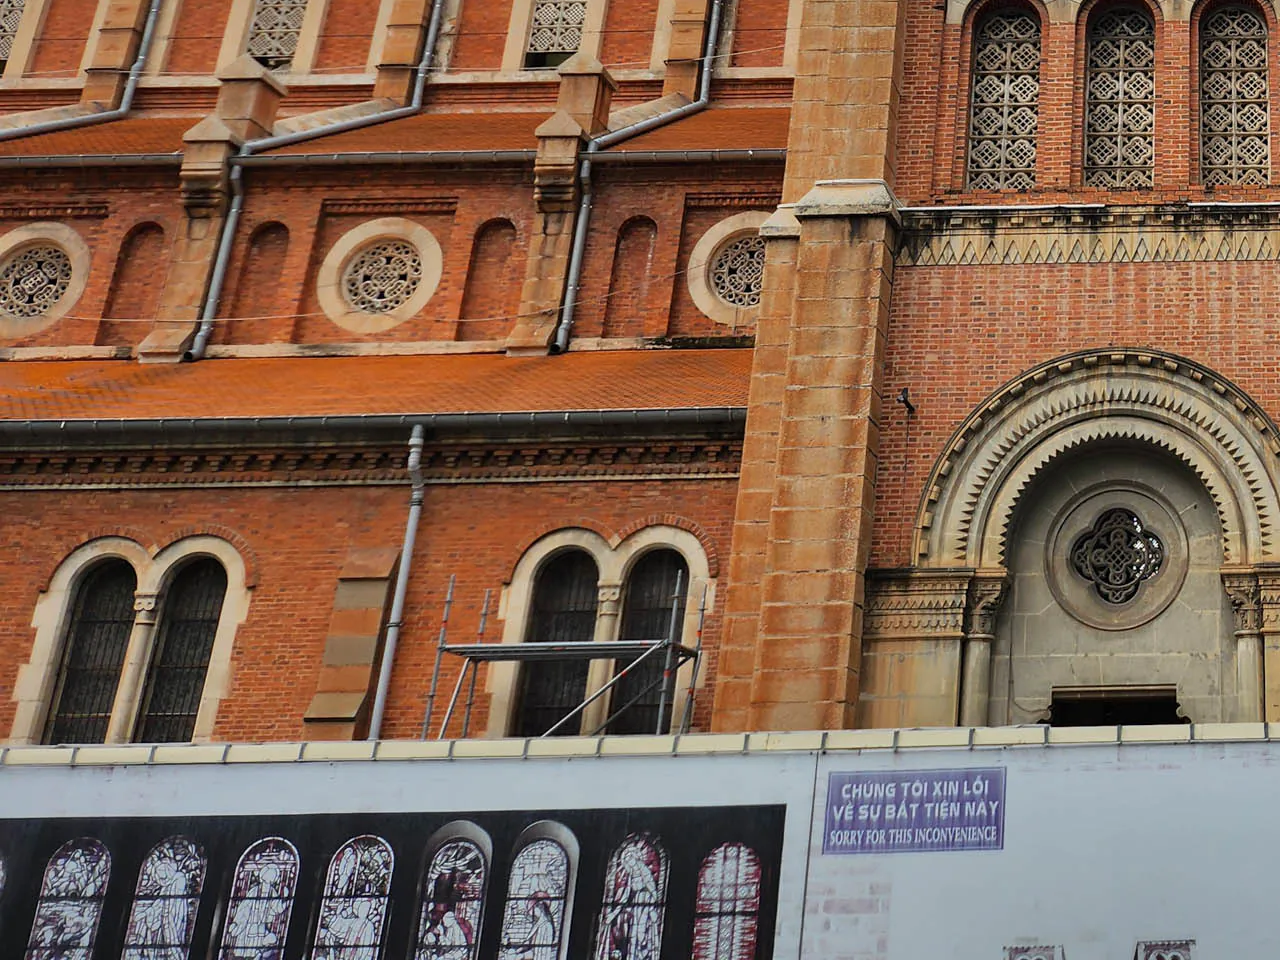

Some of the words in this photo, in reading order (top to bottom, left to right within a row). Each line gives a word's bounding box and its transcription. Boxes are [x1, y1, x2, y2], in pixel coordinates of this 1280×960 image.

[841, 780, 897, 799] CHÚNG
[901, 780, 927, 797] TÔI
[932, 780, 959, 796] XIN
[924, 800, 961, 820] TIỆN
[965, 799, 999, 818] NÀY
[830, 829, 863, 846] SORRY
[865, 828, 886, 844] FOR
[889, 827, 913, 844] THIS
[914, 825, 997, 843] INCONVENIENCE
